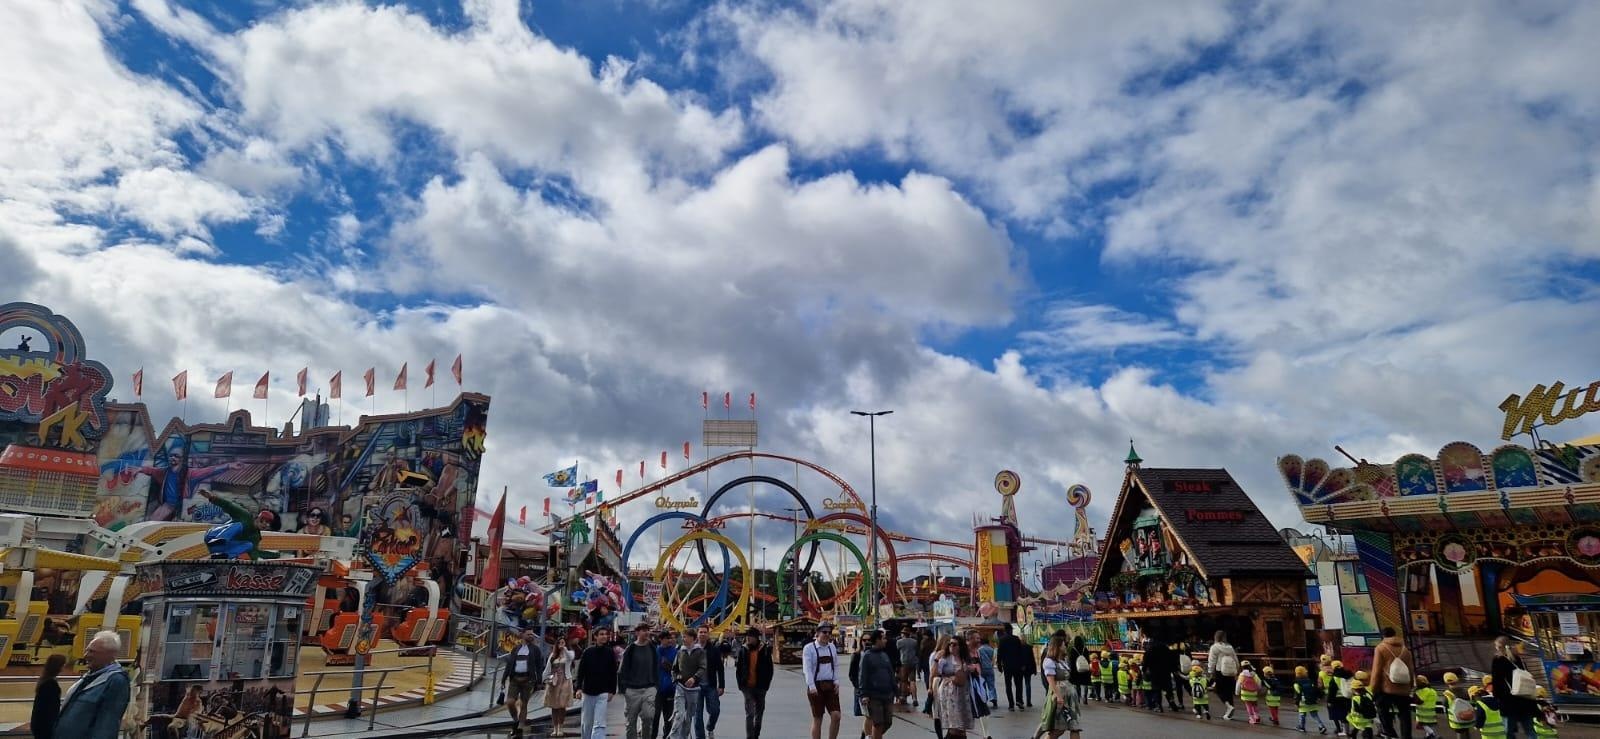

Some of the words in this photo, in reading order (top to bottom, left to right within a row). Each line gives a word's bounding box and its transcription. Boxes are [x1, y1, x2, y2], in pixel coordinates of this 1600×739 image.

[1174, 480, 1211, 493] Steak
[655, 496, 699, 509] Olympia
[1187, 509, 1243, 520] Pommes
[228, 566, 284, 589] Kasse
